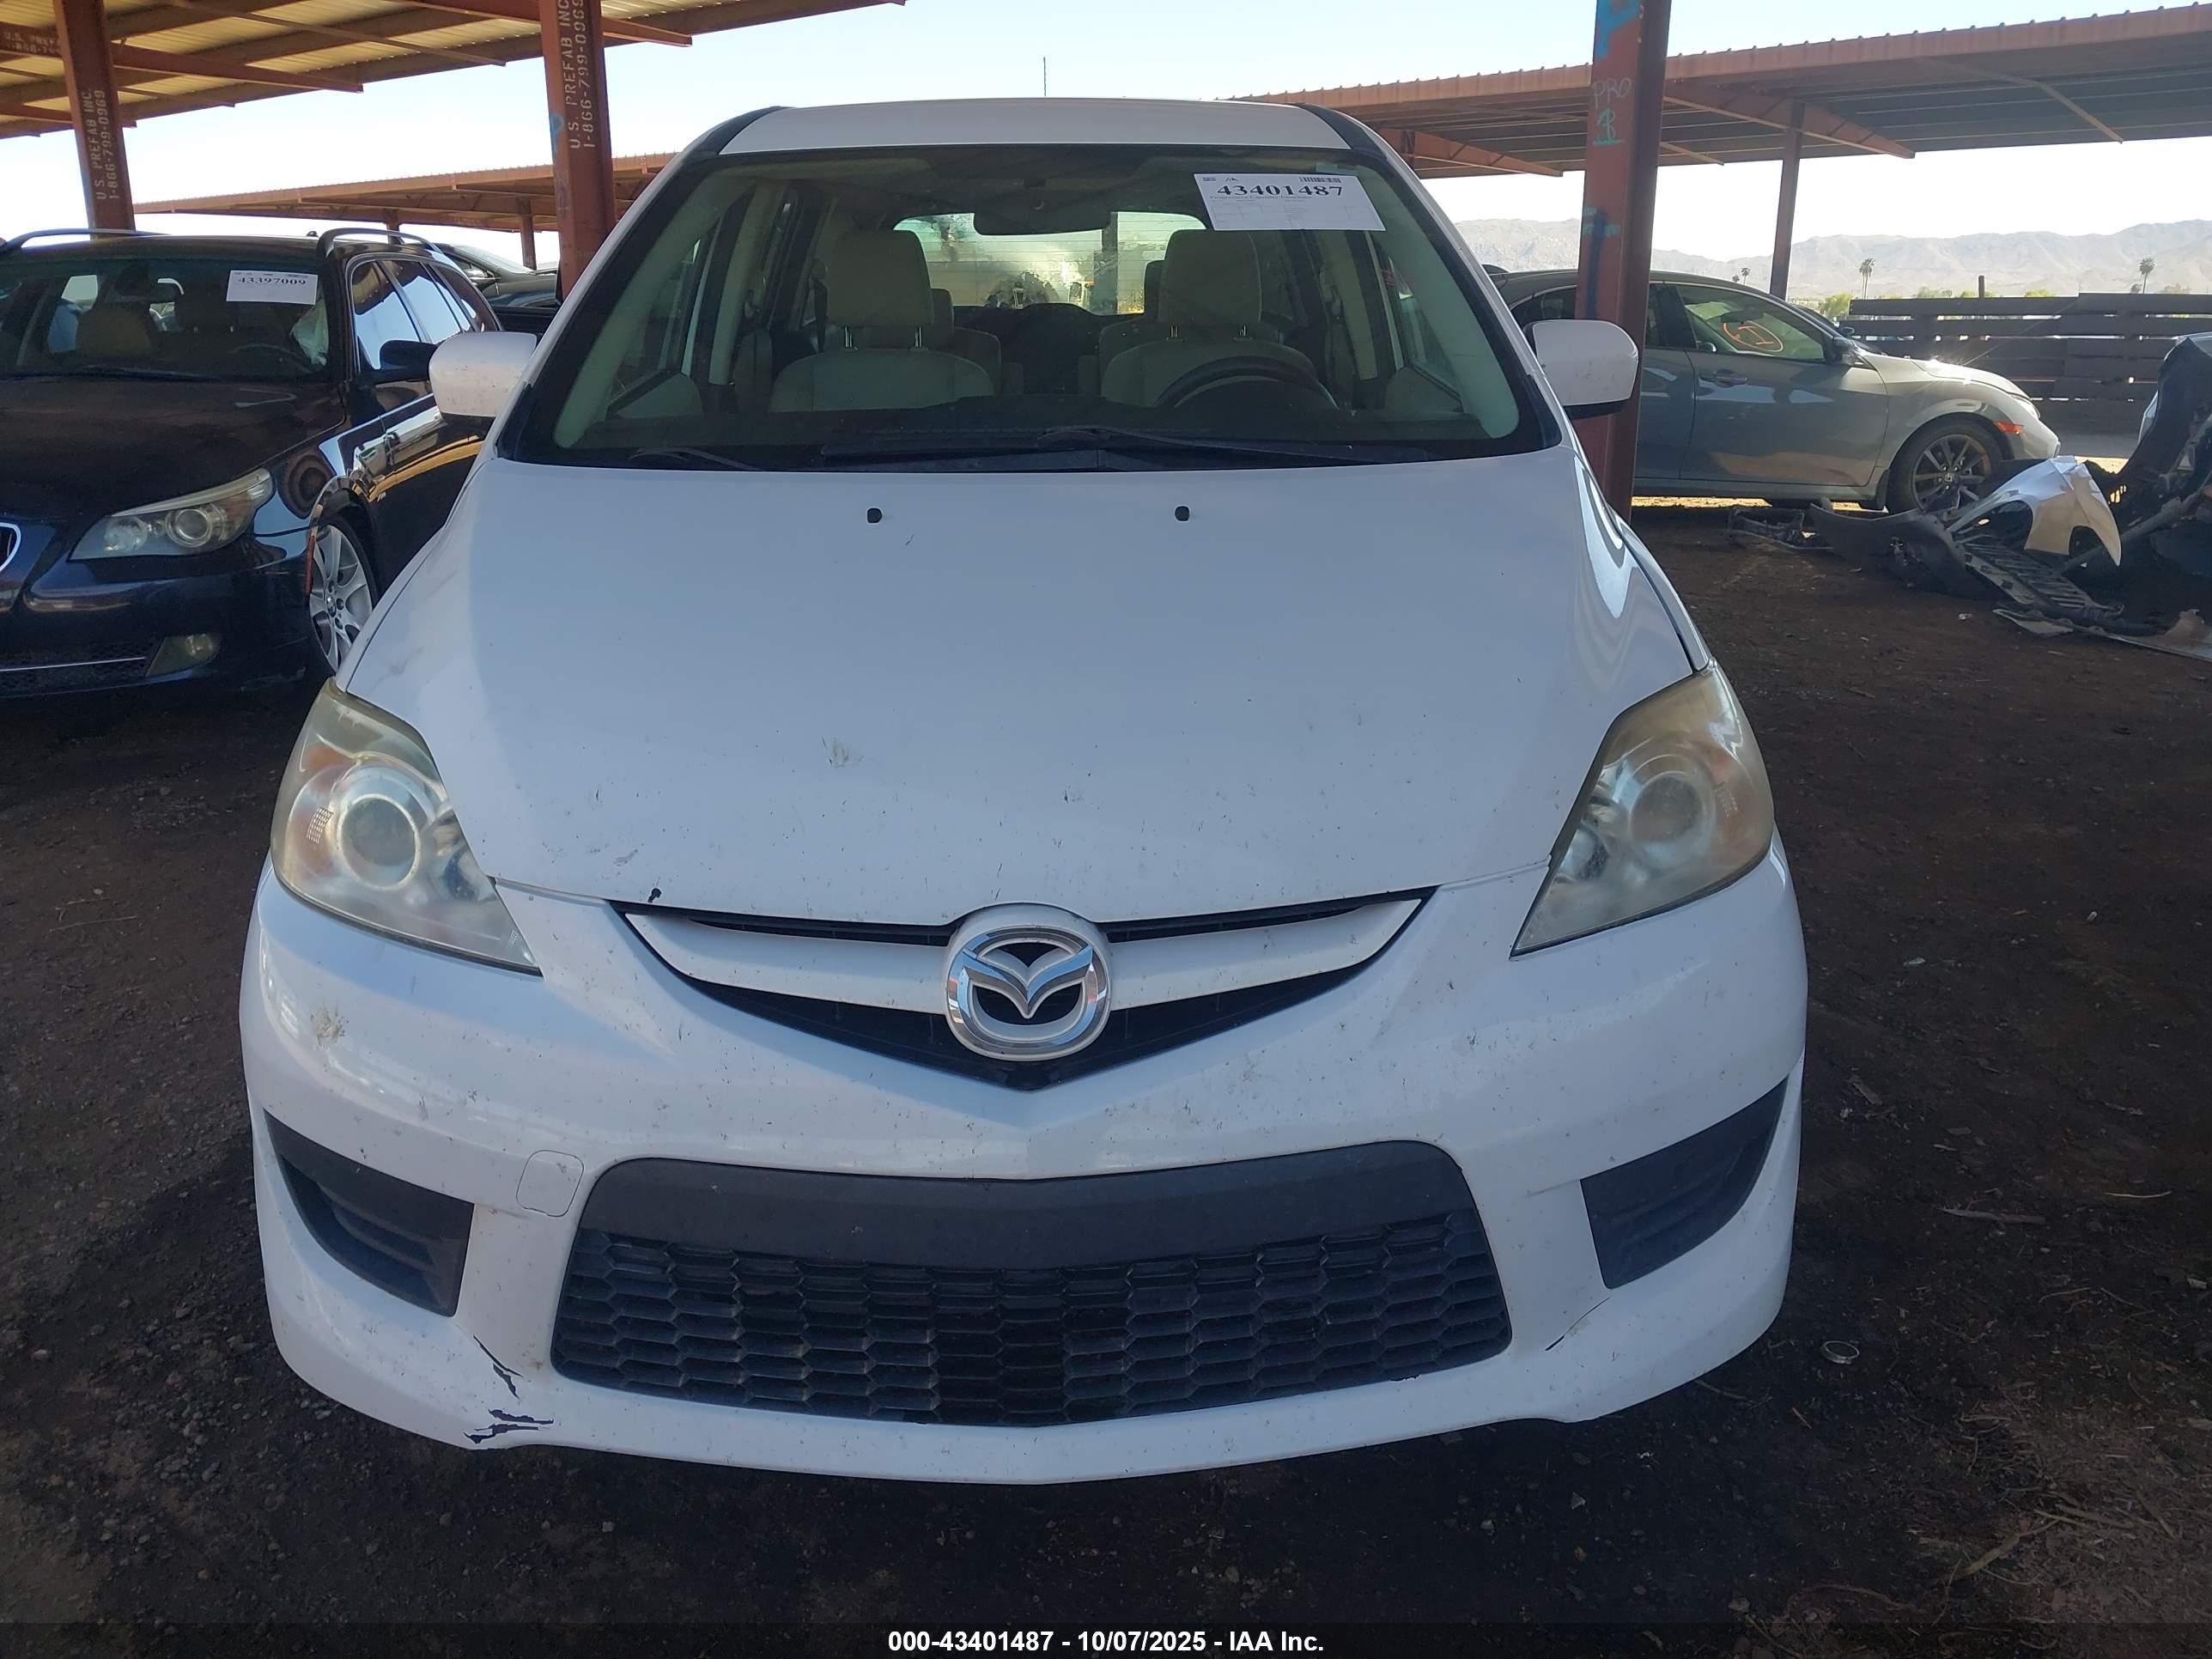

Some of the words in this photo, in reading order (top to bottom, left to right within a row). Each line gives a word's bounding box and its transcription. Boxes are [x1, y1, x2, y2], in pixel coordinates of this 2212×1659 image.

[561, 37, 578, 105] PREFAB
[86, 119, 102, 169] PREFAB
[95, 90, 119, 198] 1-866-799-0969
[1217, 185, 1343, 196] 43401487
